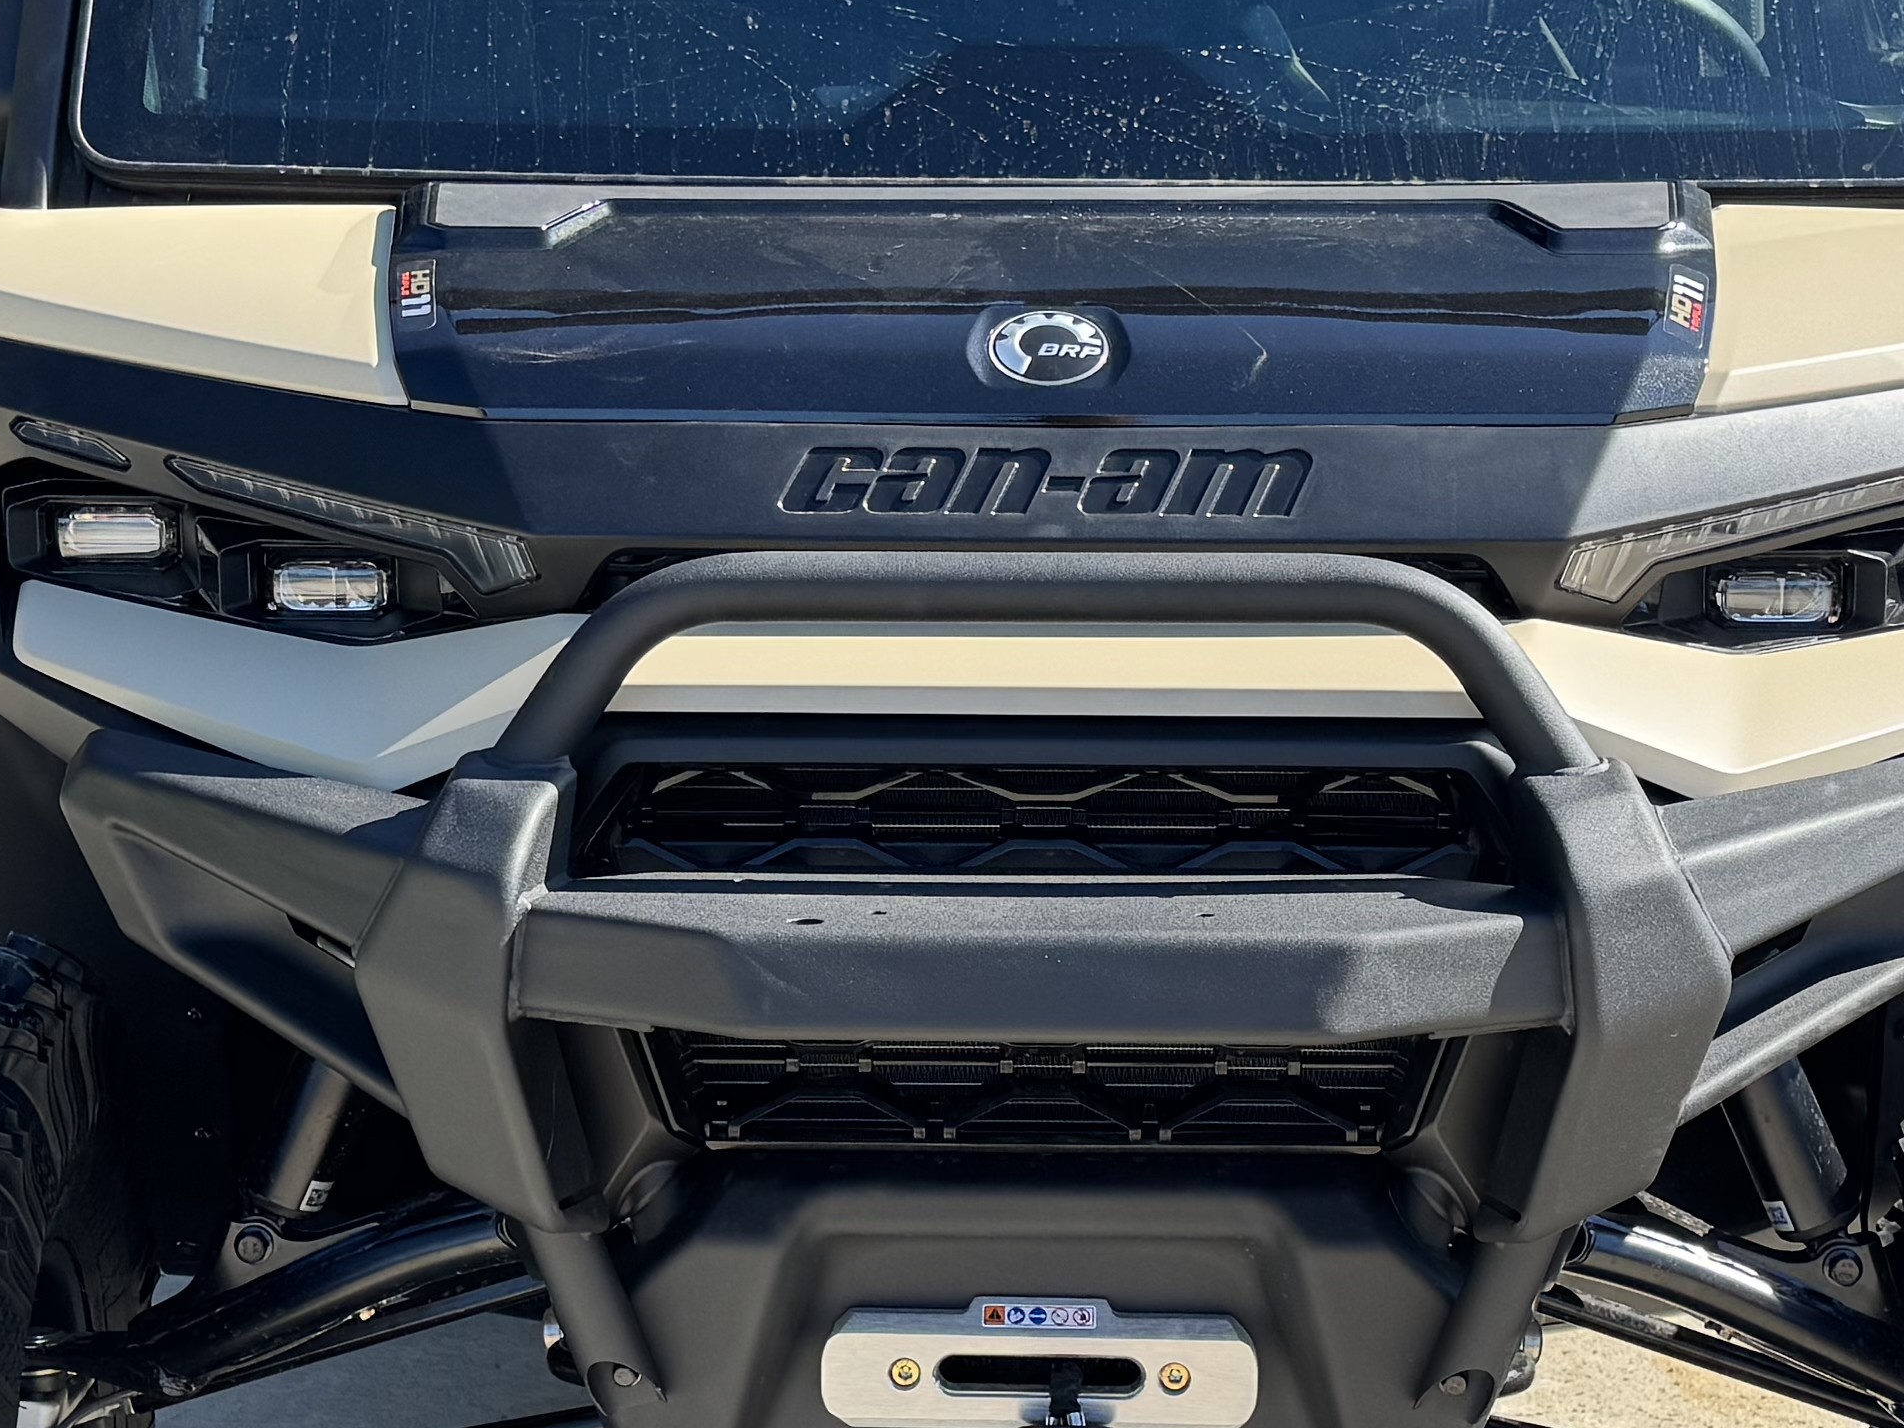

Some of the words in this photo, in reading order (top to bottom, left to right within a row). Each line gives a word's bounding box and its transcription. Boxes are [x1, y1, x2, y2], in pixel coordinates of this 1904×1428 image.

[400, 269, 432, 318] HD11
[1669, 274, 1705, 329] HD11
[1036, 342, 1102, 359] BRP
[777, 446, 1314, 518] can-am
